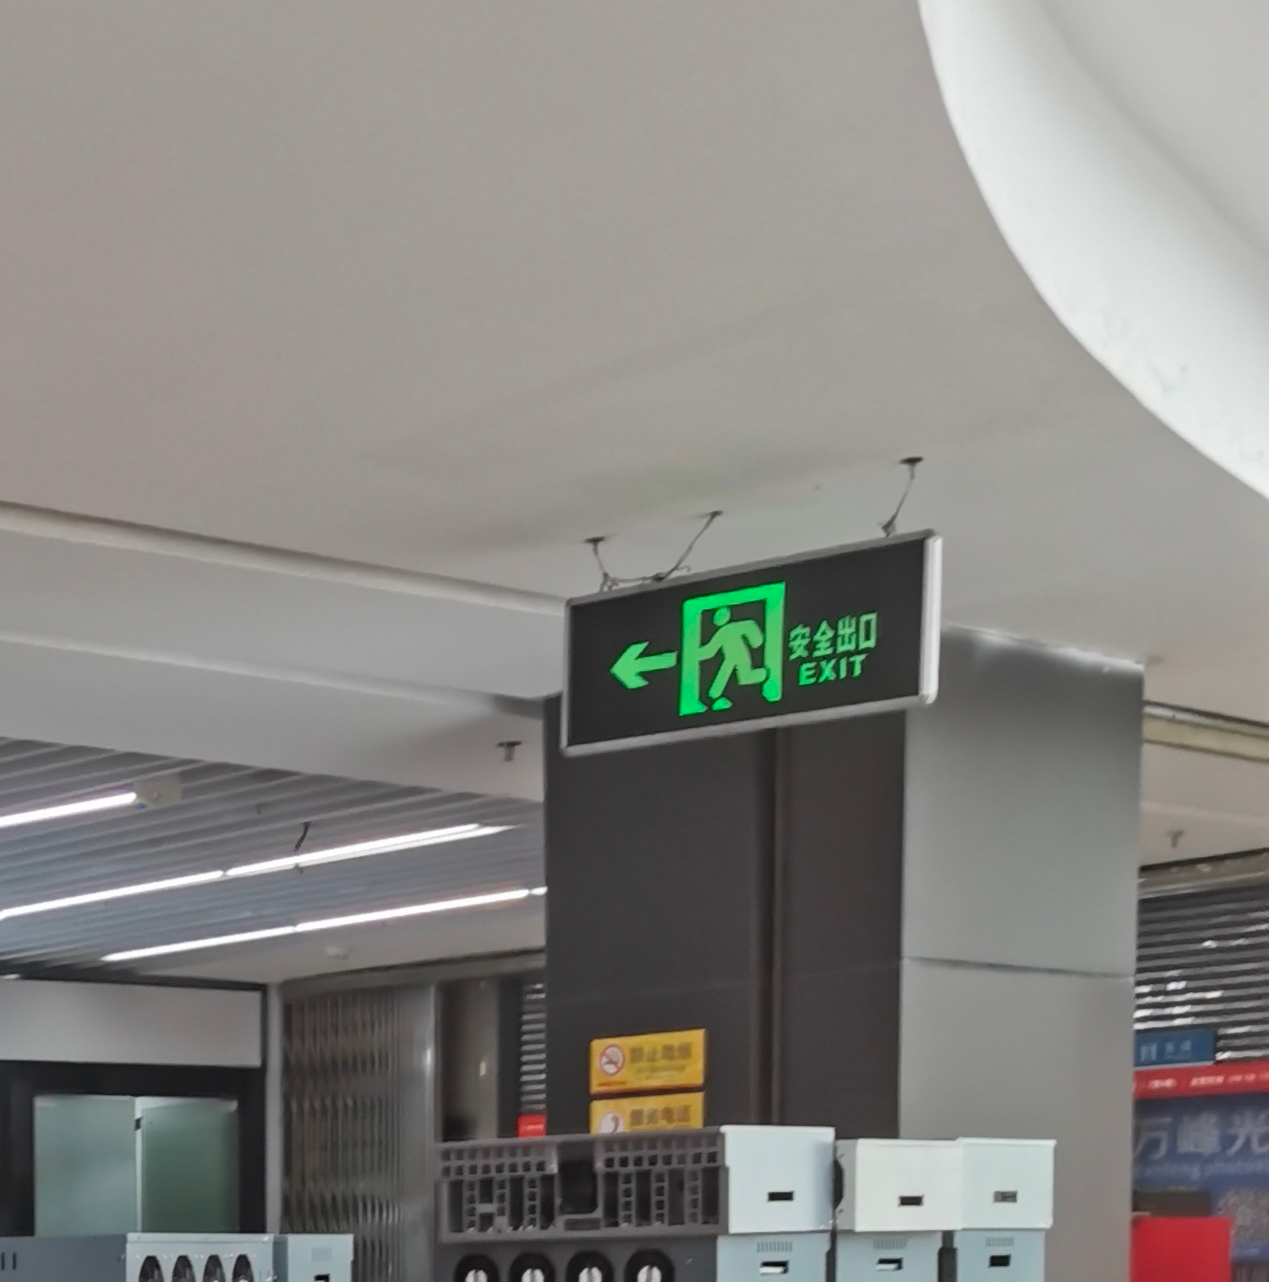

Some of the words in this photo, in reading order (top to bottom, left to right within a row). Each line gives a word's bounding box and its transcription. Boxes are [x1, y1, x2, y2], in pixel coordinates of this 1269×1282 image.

[789, 612, 878, 658] 安全出口
[798, 654, 868, 686] EXIT
